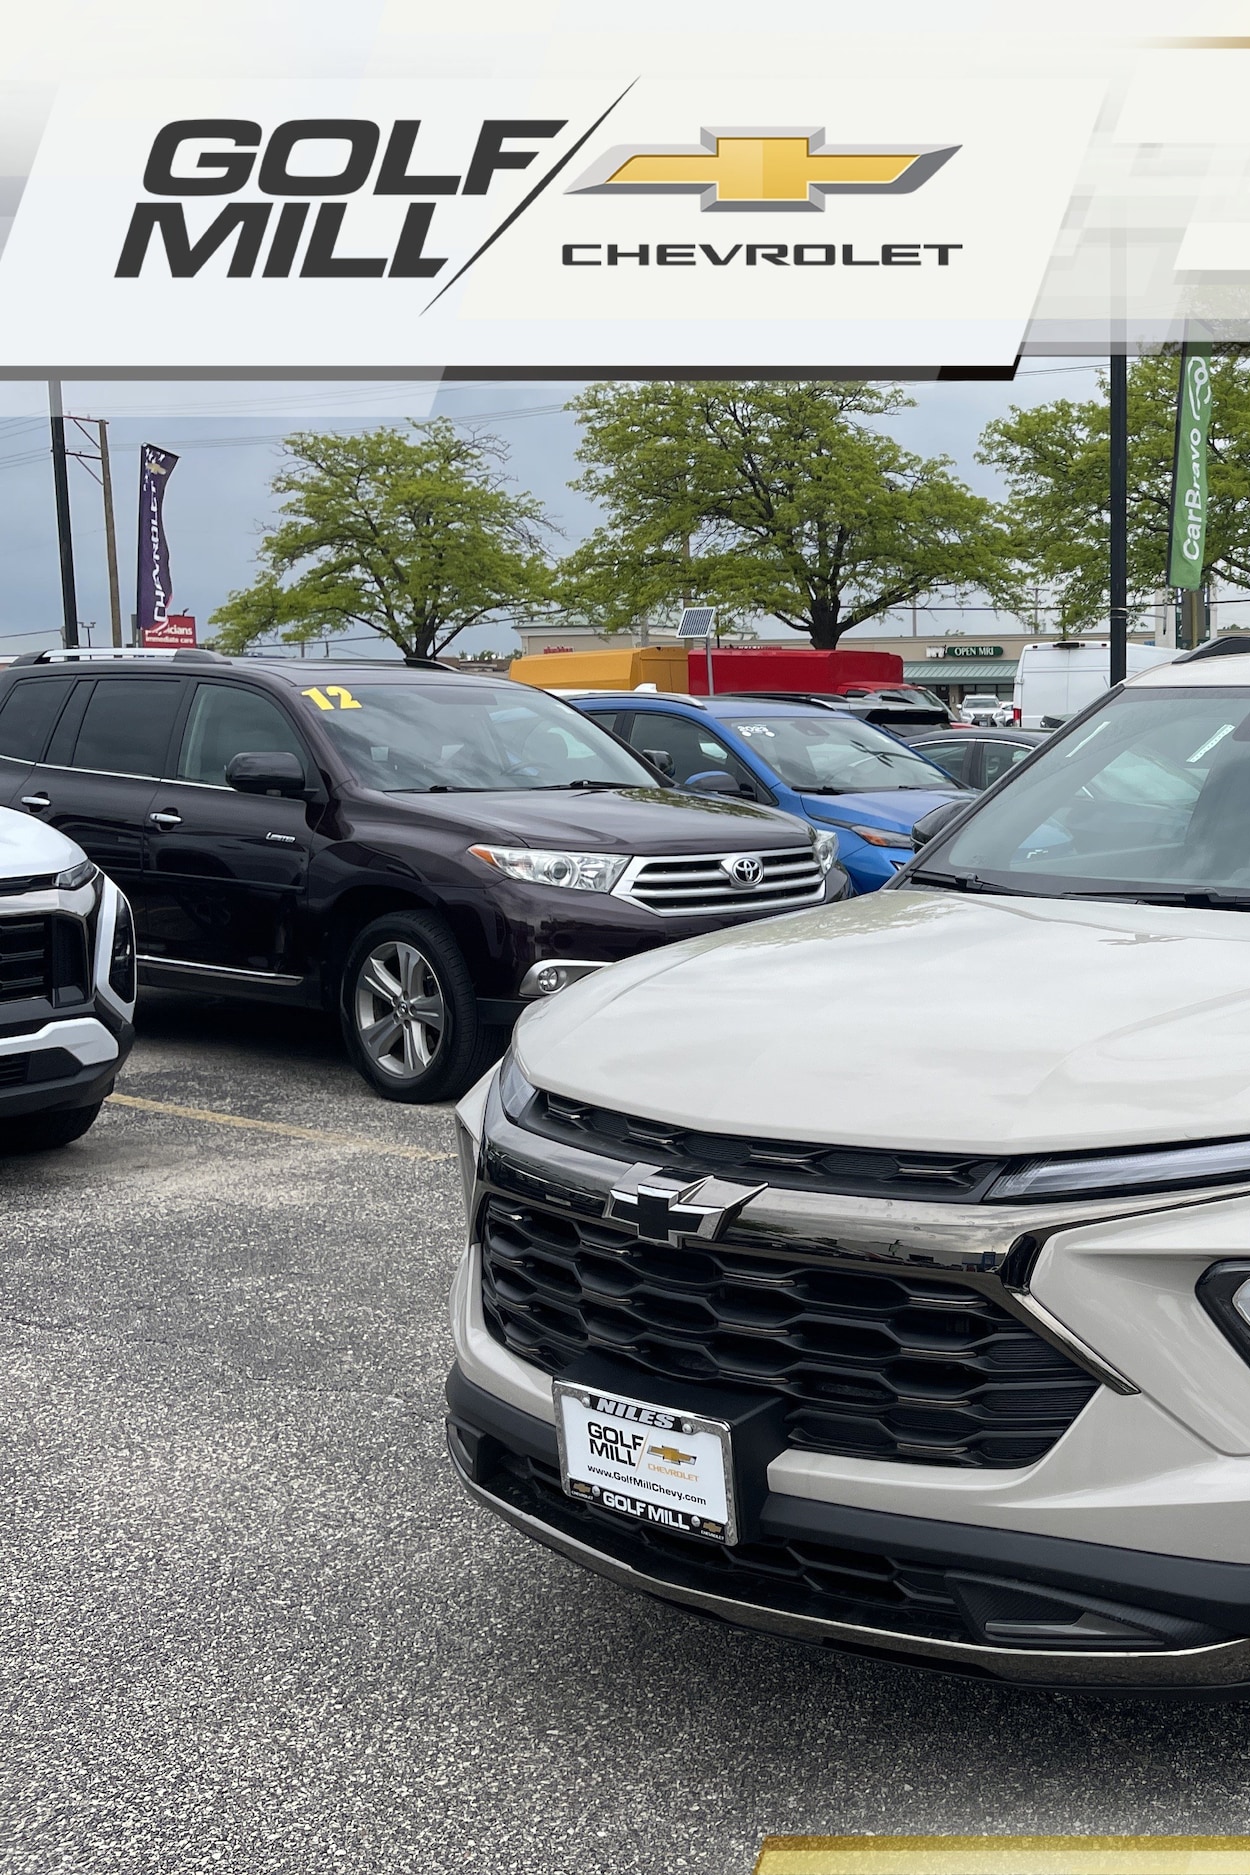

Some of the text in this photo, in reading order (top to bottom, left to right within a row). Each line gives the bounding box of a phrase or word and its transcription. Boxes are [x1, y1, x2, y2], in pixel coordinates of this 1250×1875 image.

[1183, 427, 1203, 561] CarBravo
[954, 647, 977, 656] OPEN
[979, 647, 994, 656] MRI
[301, 686, 362, 711] 12
[597, 1398, 675, 1429] NILES
[588, 1421, 644, 1451] GOLF
[589, 1439, 636, 1467] MILL
[587, 1464, 707, 1506] www.GolfMillChevy.com
[647, 1463, 699, 1483] CHEVROLET
[602, 1490, 690, 1531] GOLF MILL
